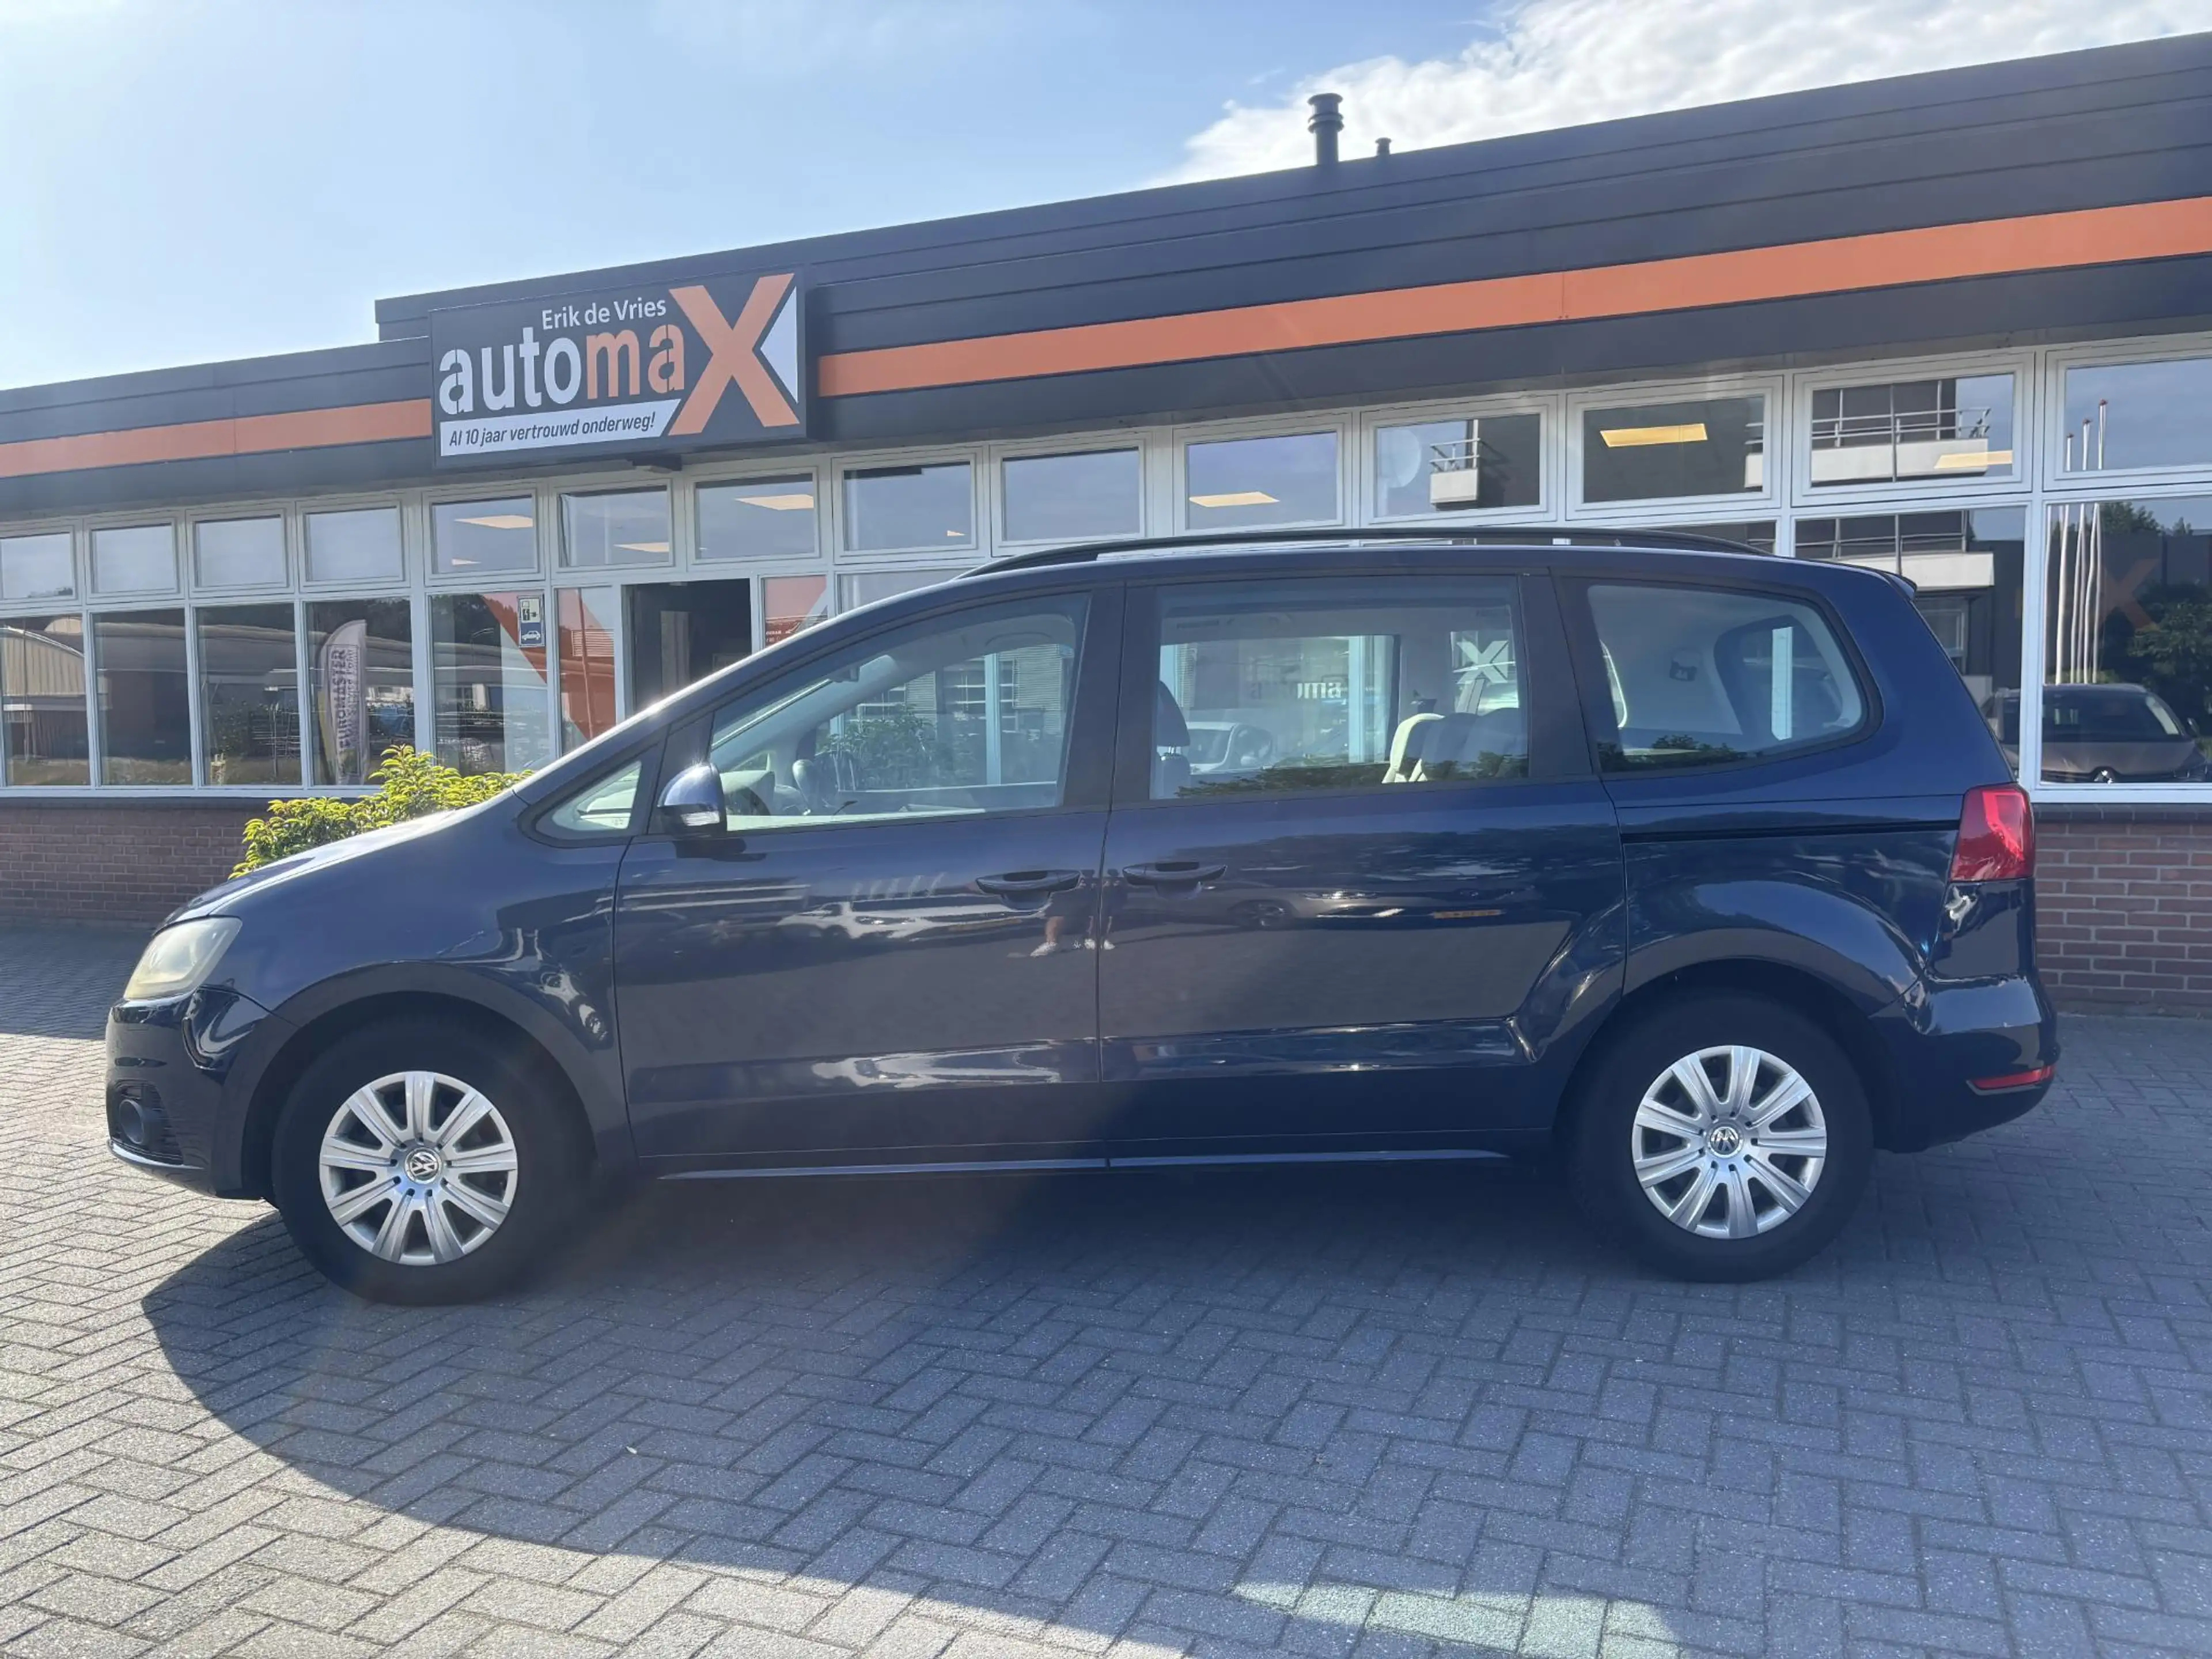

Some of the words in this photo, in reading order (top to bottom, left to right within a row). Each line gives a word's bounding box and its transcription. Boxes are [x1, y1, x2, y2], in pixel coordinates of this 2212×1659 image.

[542, 305, 581, 330] Erik
[584, 302, 611, 325] de
[613, 297, 666, 321] Vries
[449, 430, 462, 446] Al
[465, 429, 479, 445] 10
[479, 427, 507, 447] jaar
[510, 418, 579, 441] vertrouwd
[582, 411, 656, 434] onderweg!
